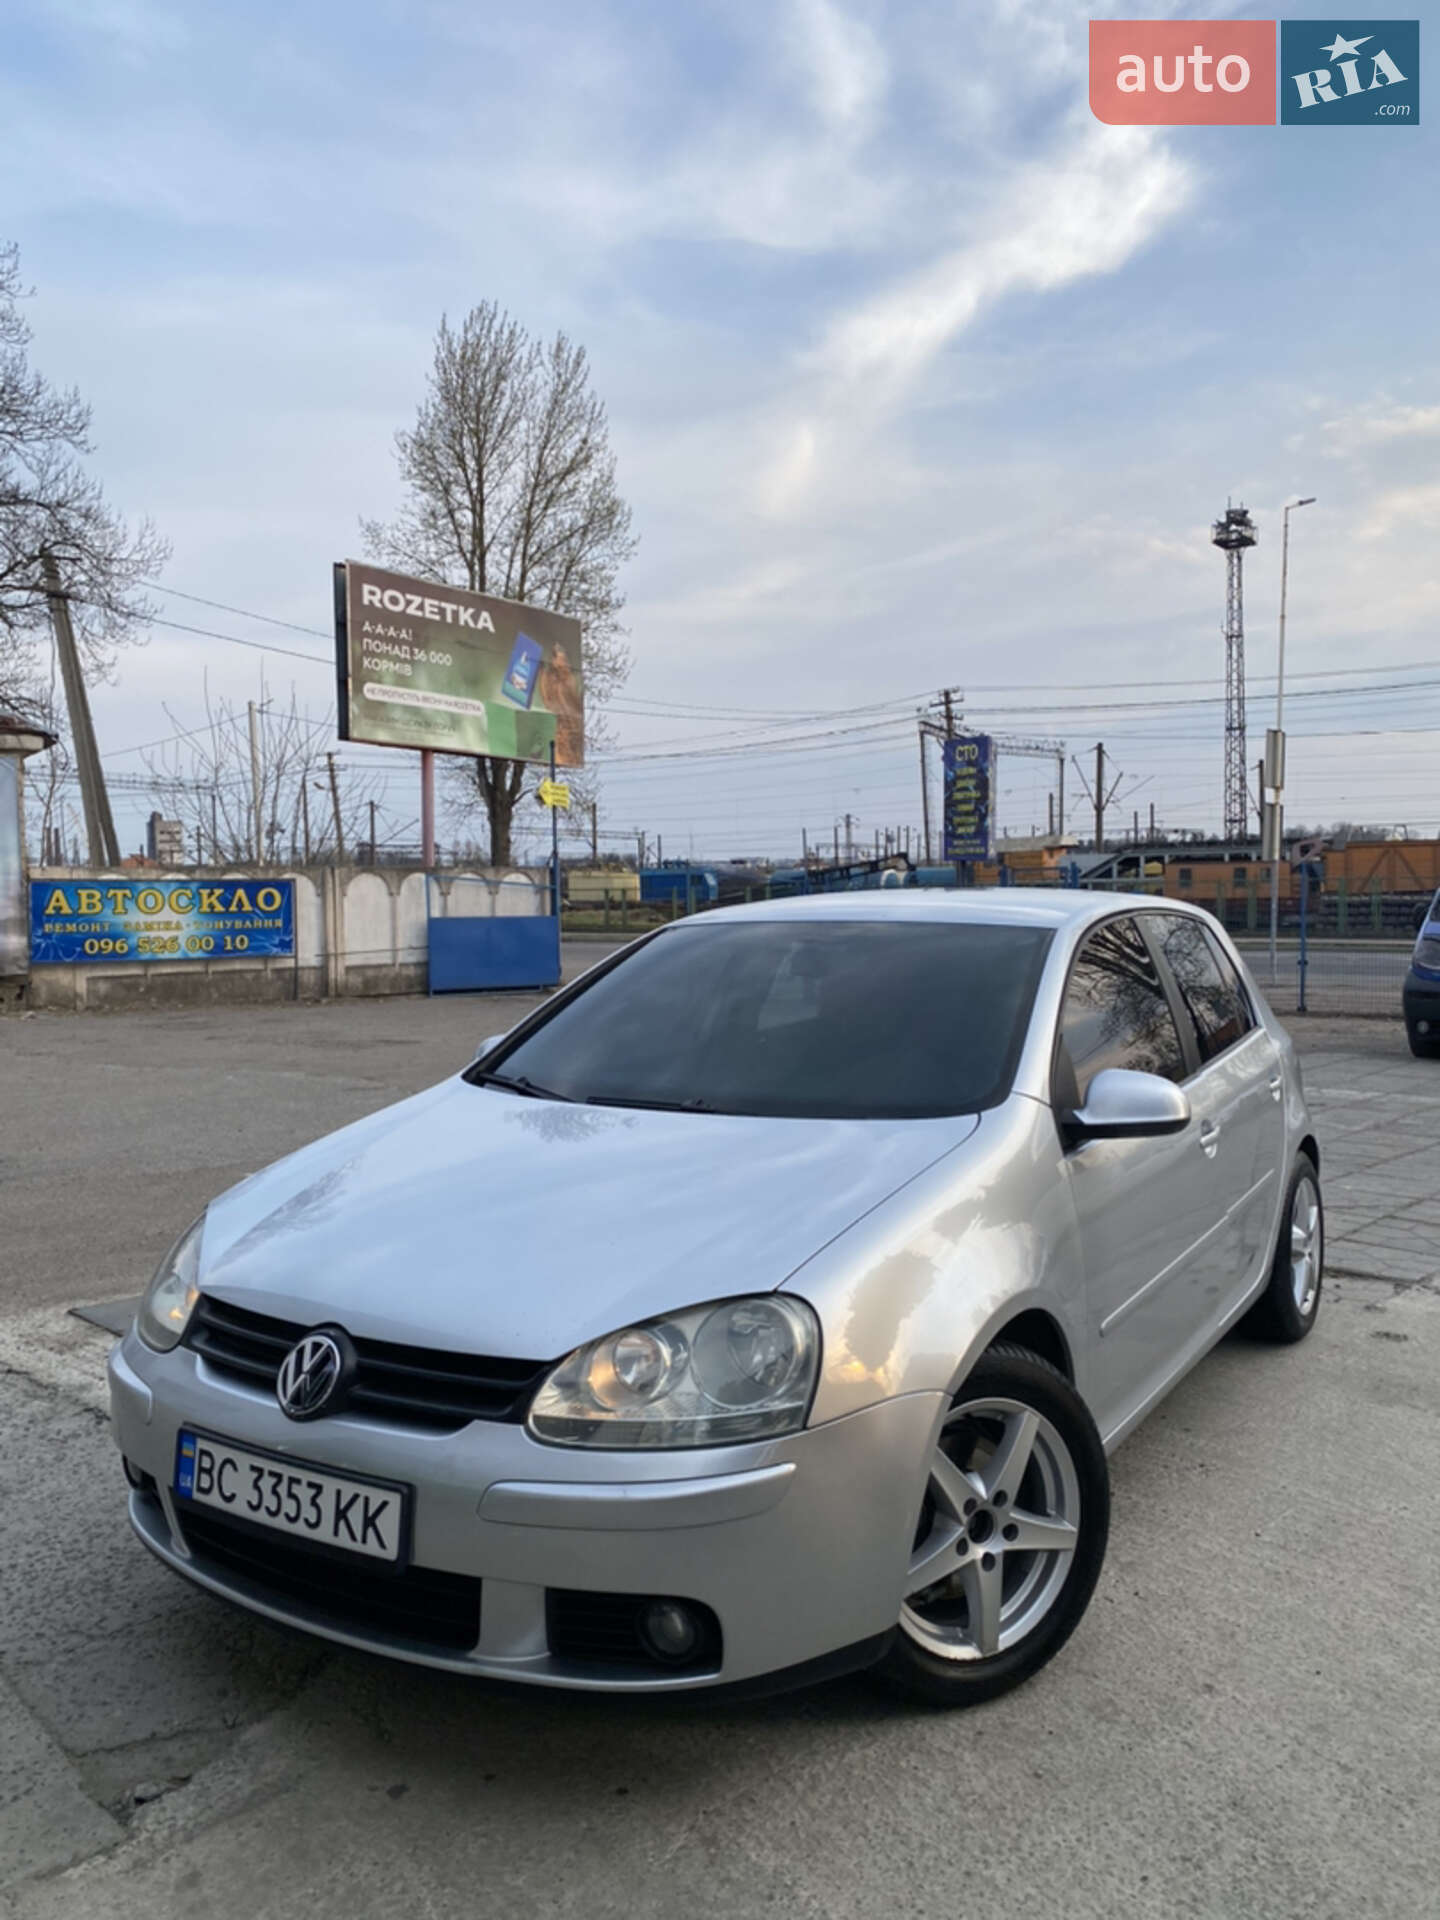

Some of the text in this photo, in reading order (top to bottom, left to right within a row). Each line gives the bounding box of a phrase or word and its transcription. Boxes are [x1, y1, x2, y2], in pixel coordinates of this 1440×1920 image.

[361, 583, 496, 633] ROZETKA
[362, 639, 453, 666] ПОНАД 36 000
[362, 657, 413, 676] КОРМІВ
[44, 888, 283, 915] АВТОСКЛО
[43, 921, 111, 934] РЕМОНТ
[84, 934, 249, 955] 096 526 00 10
[196, 1448, 389, 1551] BC 3353 KK
